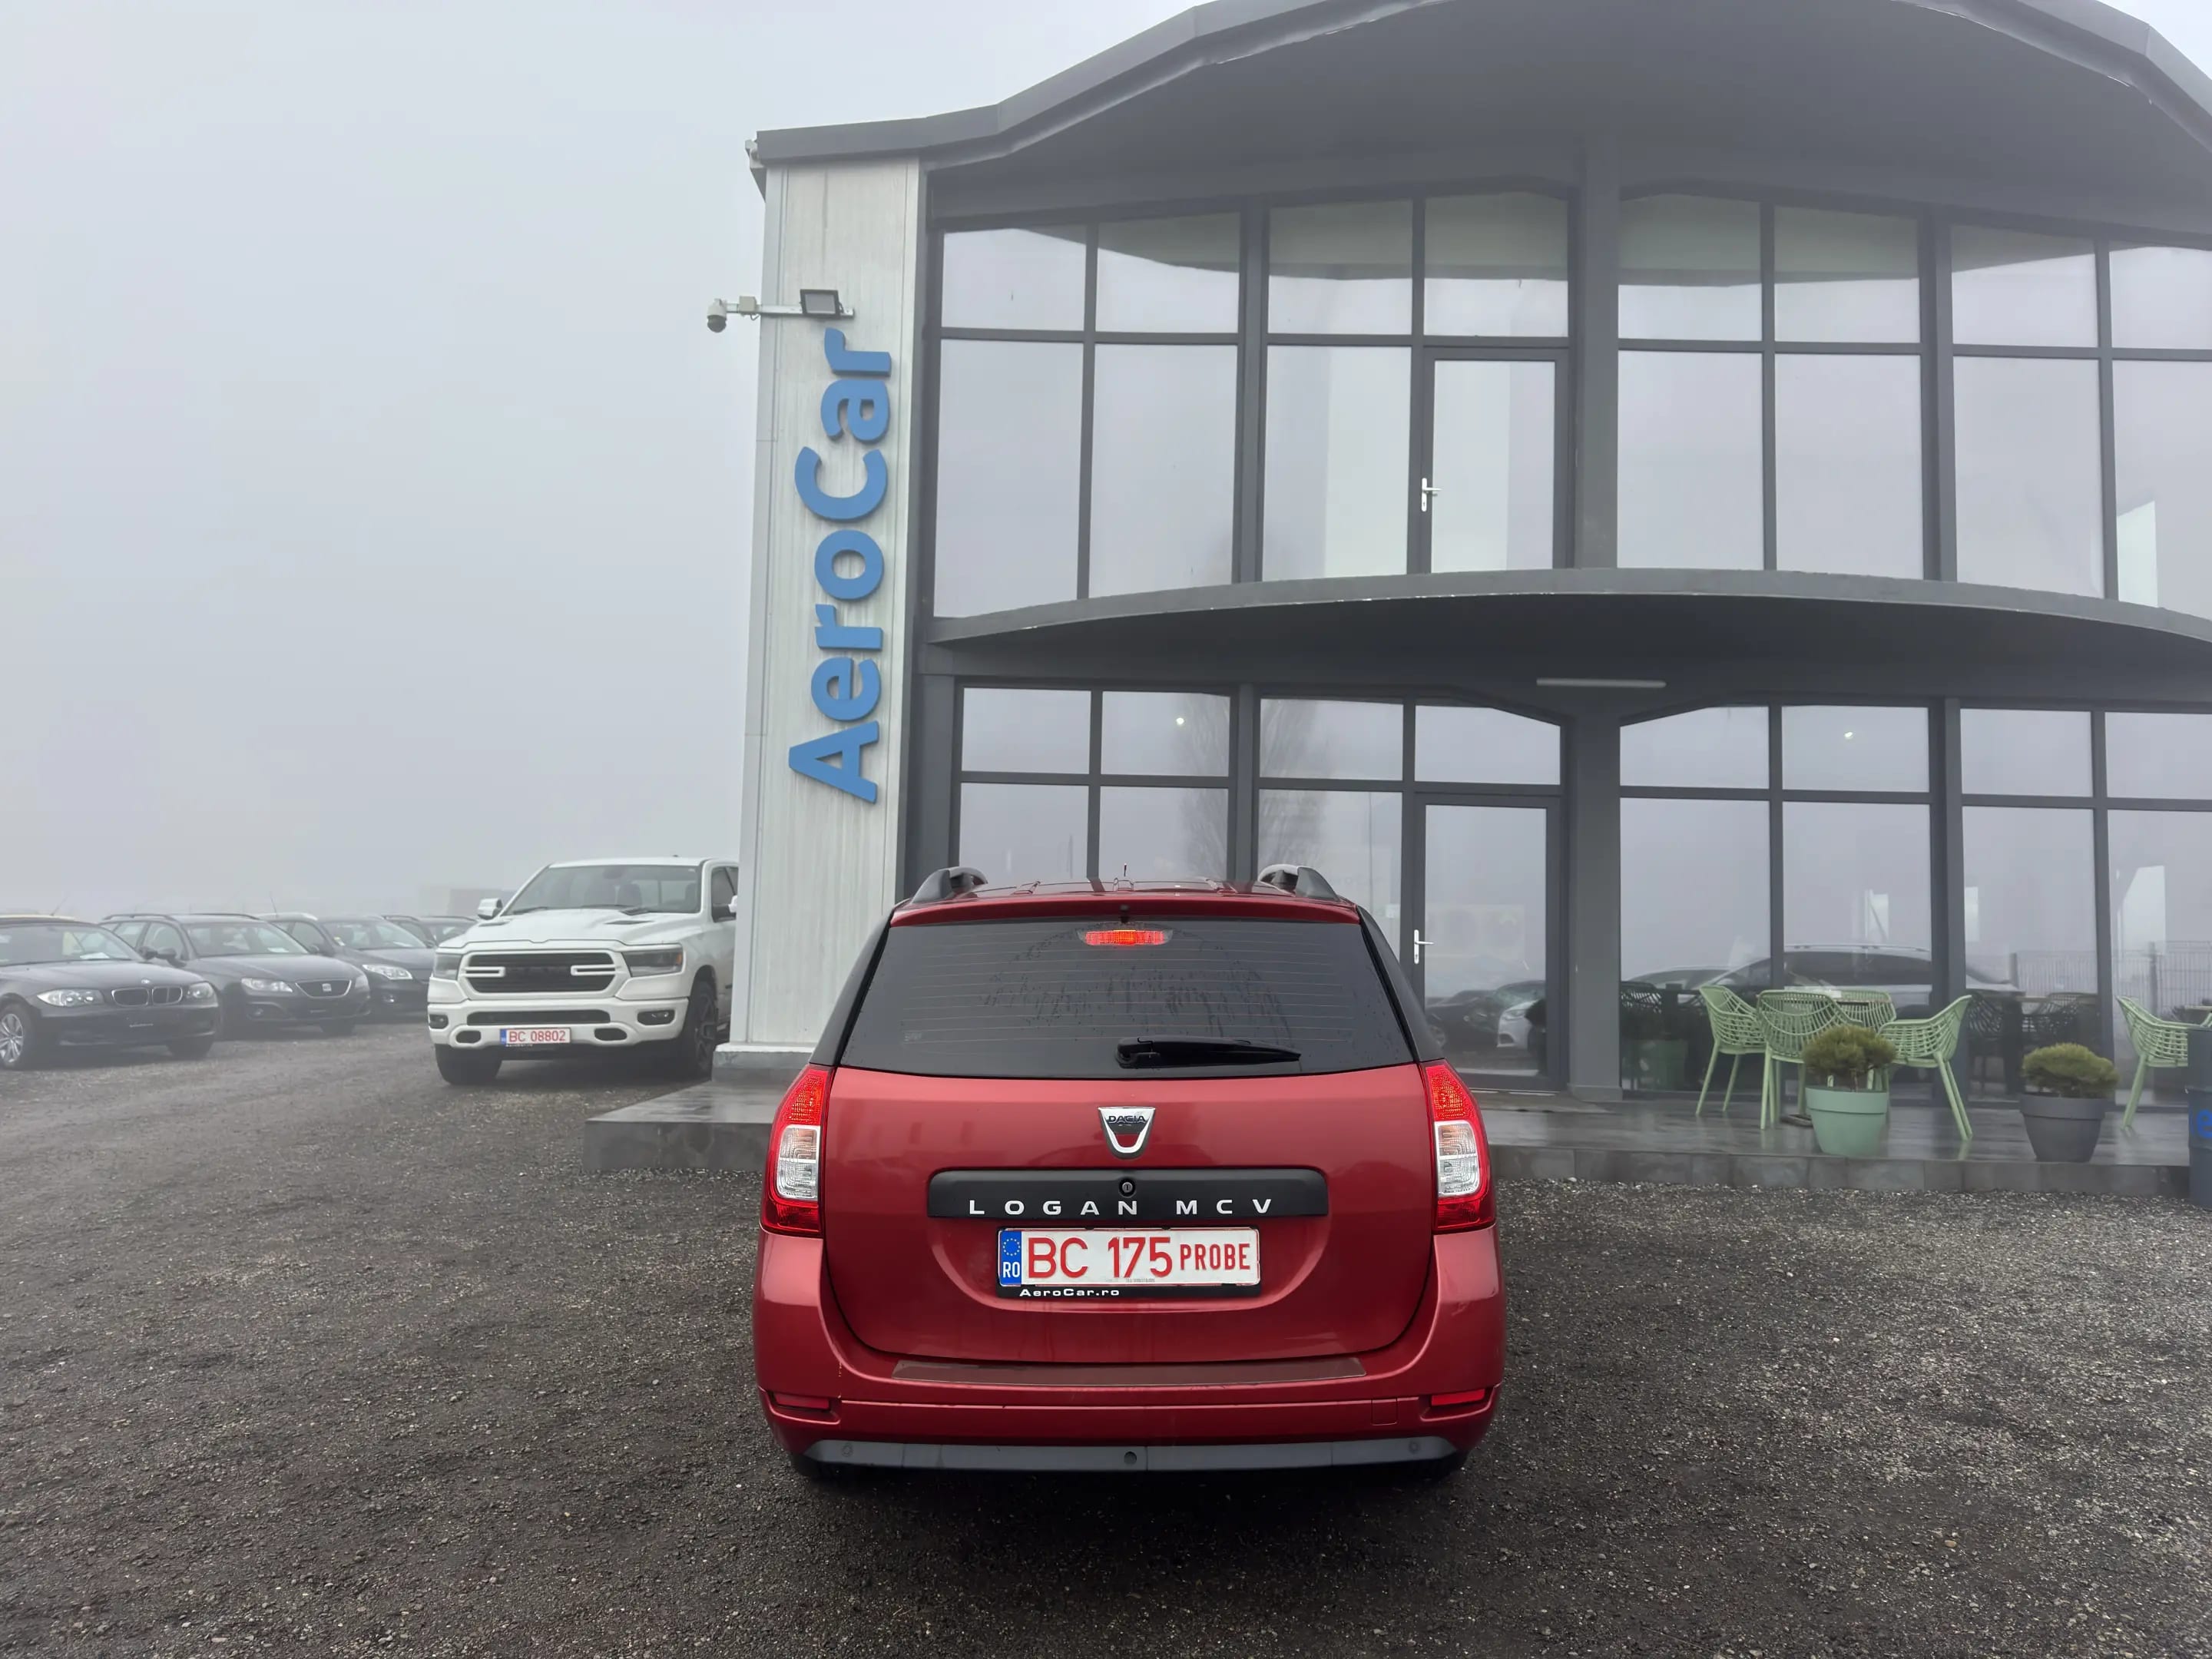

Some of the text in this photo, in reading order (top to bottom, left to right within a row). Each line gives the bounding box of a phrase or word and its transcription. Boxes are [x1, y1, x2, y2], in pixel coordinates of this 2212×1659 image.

[789, 327, 891, 804] AeroCar
[509, 1031, 525, 1042] BC
[531, 1030, 565, 1041] 08802
[1108, 1115, 1146, 1124] DACIA
[969, 1198, 1271, 1215] LOGAN MCV
[1028, 1237, 1250, 1279] BC 175 PROBE
[1002, 1262, 1020, 1277] RO
[1019, 1288, 1120, 1297] AeroCar.ro
